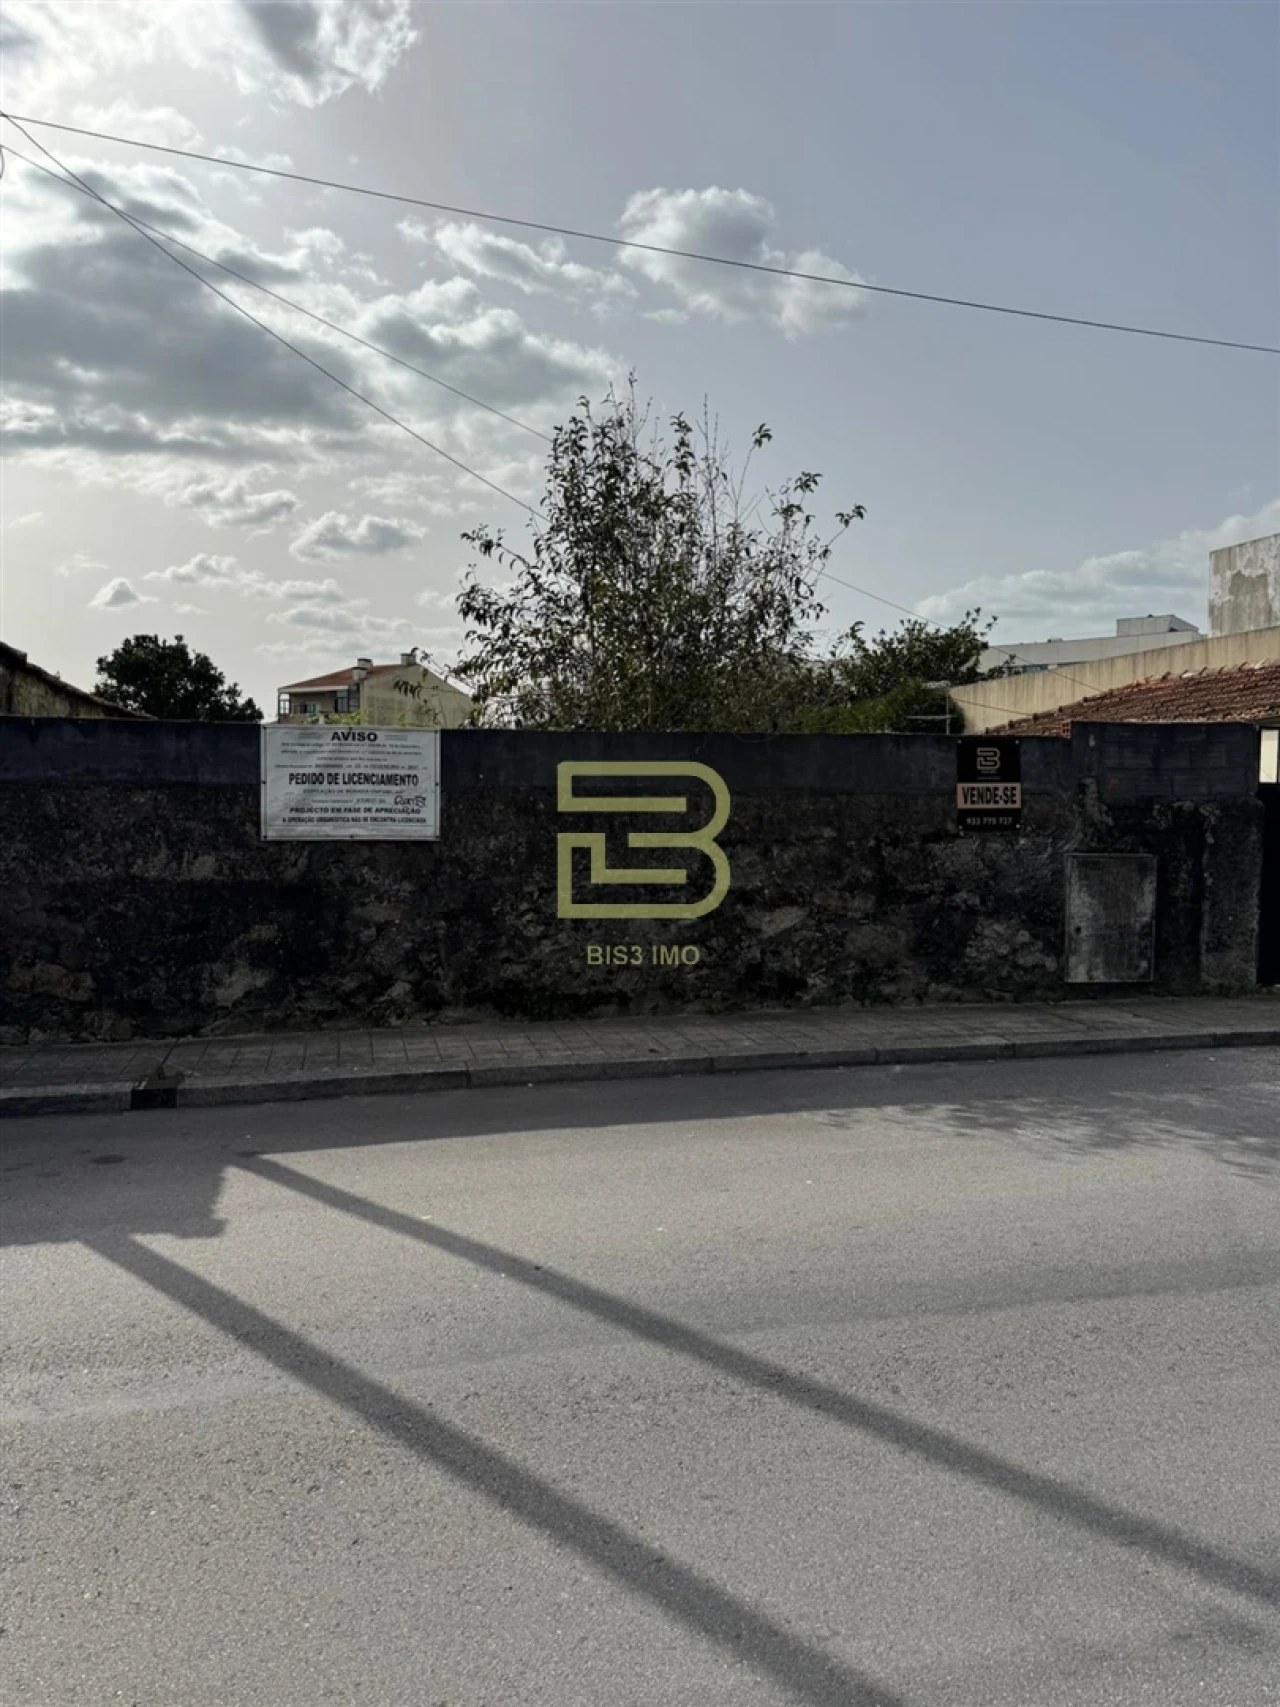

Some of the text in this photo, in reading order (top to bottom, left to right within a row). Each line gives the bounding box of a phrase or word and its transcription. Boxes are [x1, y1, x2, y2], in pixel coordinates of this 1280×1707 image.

[331, 731, 378, 742] AVISO
[288, 772, 420, 787] PEDIDO DE LICENCIAMENTO
[961, 786, 1017, 805] VENDE-SE
